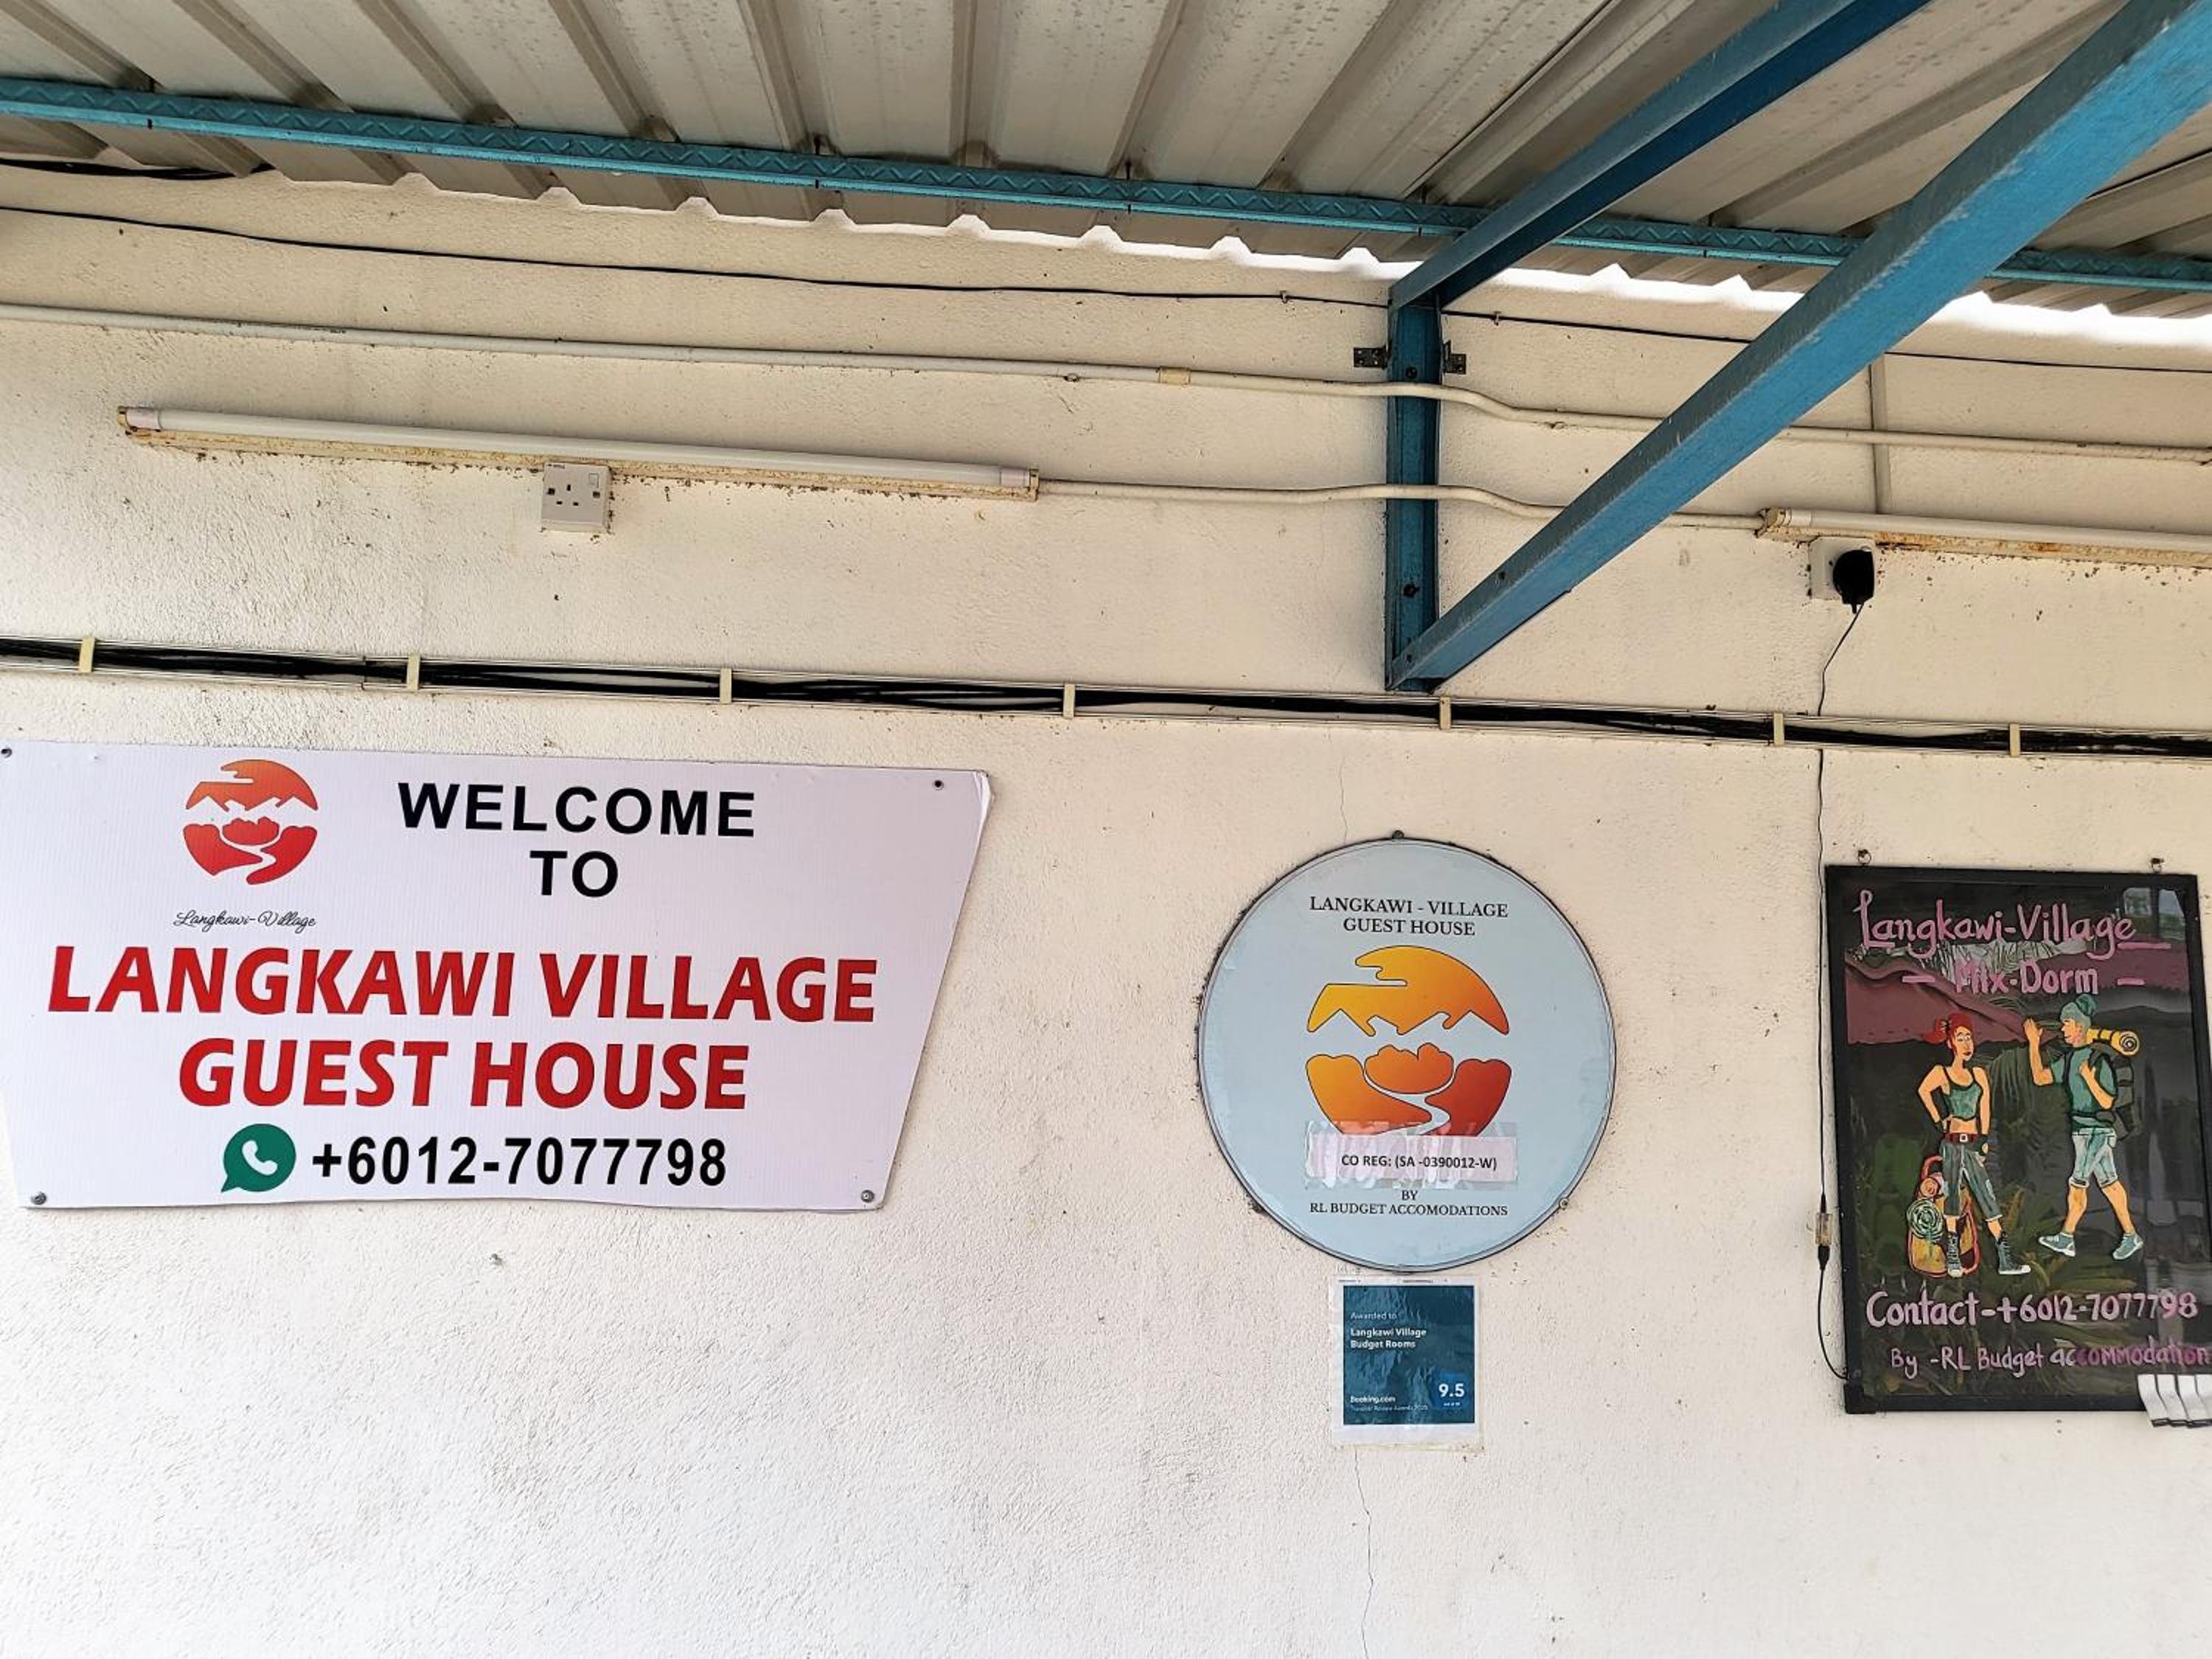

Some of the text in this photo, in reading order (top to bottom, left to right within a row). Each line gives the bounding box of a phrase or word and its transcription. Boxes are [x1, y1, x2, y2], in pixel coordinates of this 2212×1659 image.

[398, 782, 754, 837] WELCOME
[529, 850, 619, 897] TO
[1310, 896, 1413, 914] LANGKAWI
[1427, 900, 1509, 917] VILLAGE
[173, 910, 316, 934] Langkawi-Village
[1343, 917, 1475, 936] GUEST HOUSE
[1854, 890, 2137, 959] Langkawi-Village
[48, 946, 877, 1022] LANGKAWI VILLAGE
[1955, 959, 2099, 995] Mix-Dorm
[179, 1038, 748, 1109] GUEST HOUSE
[312, 1135, 726, 1186] +6012-7077798
[1341, 1155, 1497, 1171] CO REG: (SA -0390012-W)
[1401, 1190, 1418, 1201] BY
[1310, 1203, 1509, 1217] RL BUDGET ACCOMODATIONS
[1350, 1312, 1397, 1320] Awarded to
[1350, 1327, 1427, 1338] Langkawi Village
[1350, 1340, 1416, 1350] Budget Rooms
[1891, 1348, 1918, 1380] By
[1978, 1343, 2044, 1378] Budget
[1350, 1394, 1396, 1404] Booking.com
[1439, 1382, 1465, 1398] 9.5
